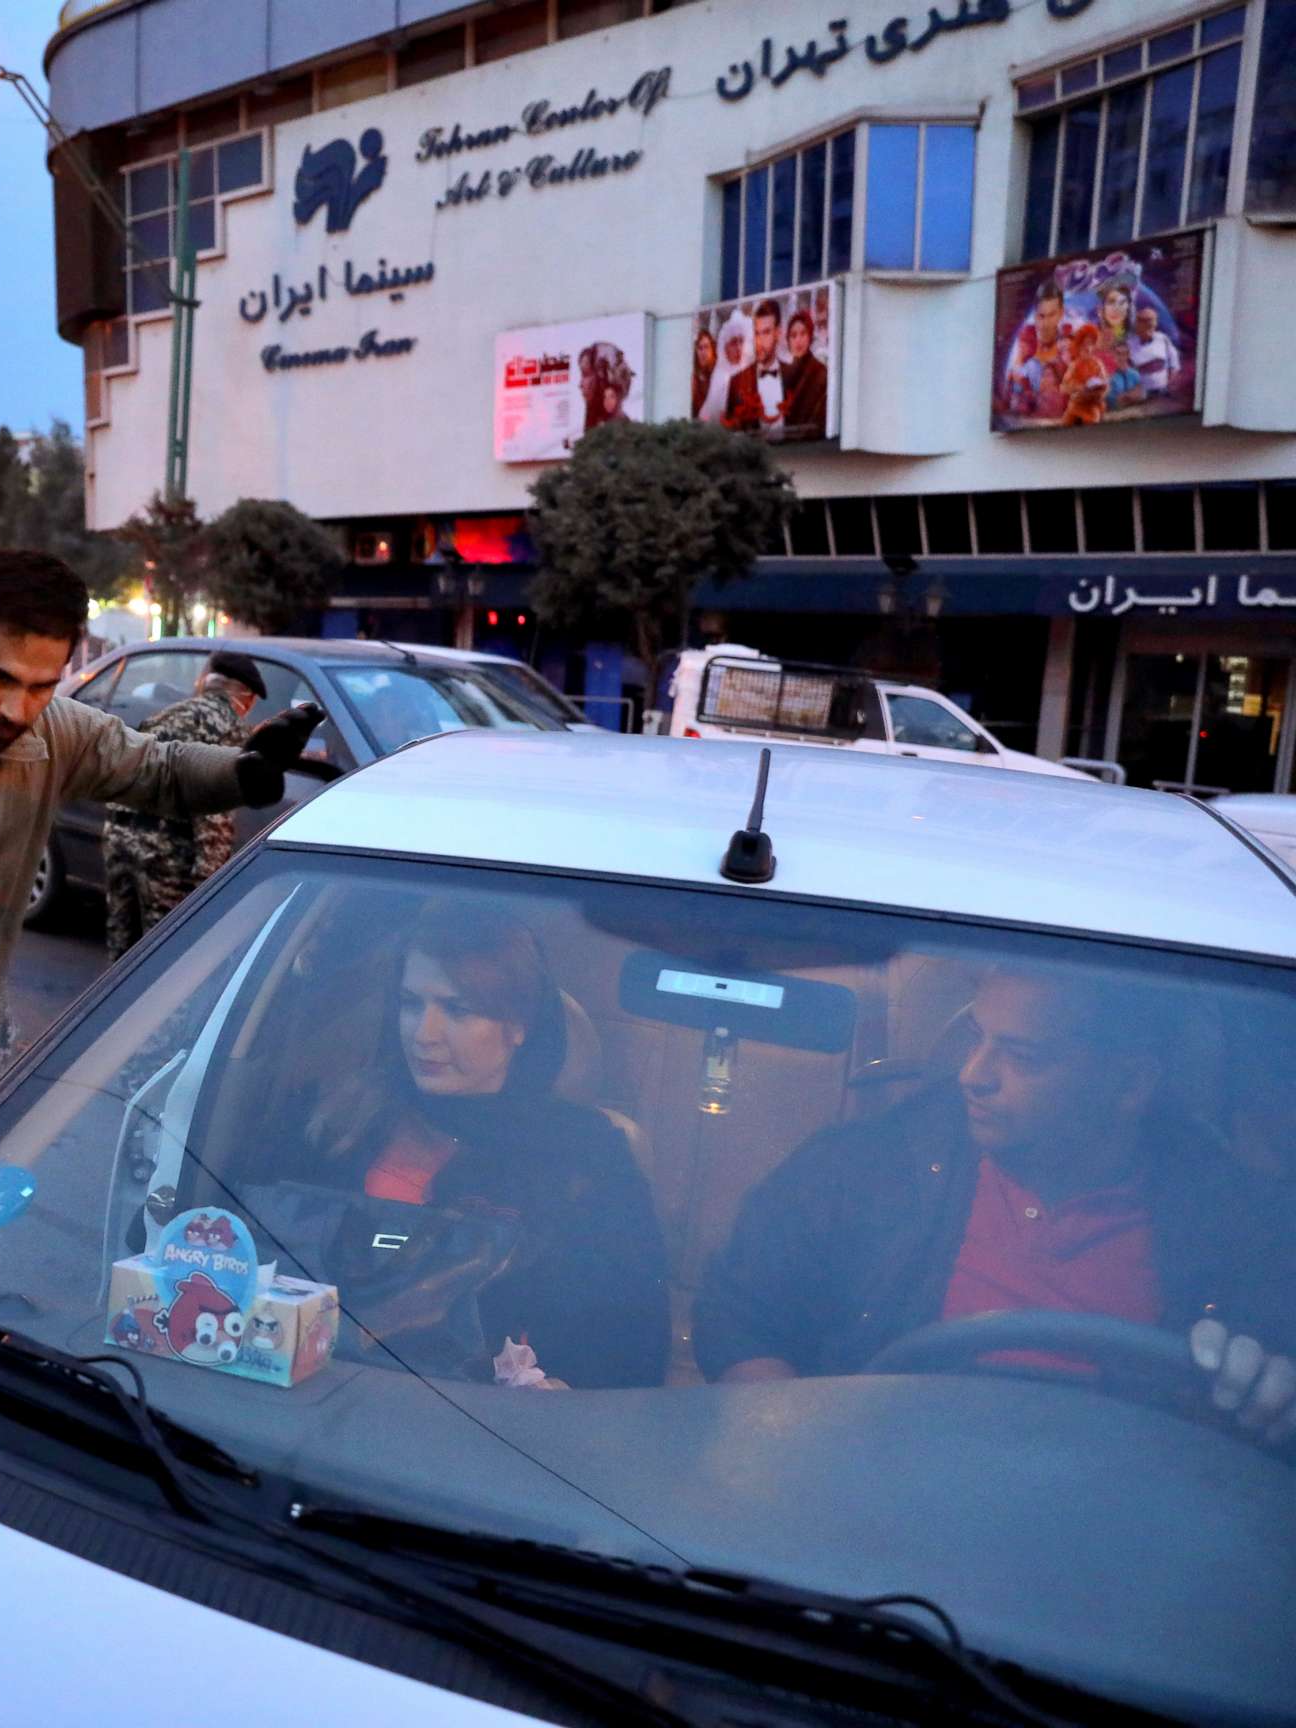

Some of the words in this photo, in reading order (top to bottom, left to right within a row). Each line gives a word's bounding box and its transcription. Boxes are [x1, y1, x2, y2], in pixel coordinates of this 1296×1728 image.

[716, 16, 851, 102] تهران
[415, 123, 516, 163] Tehran
[521, 88, 625, 135] Center
[435, 170, 491, 209] Art
[523, 147, 643, 189] Culture
[239, 265, 329, 324] ایران
[344, 258, 435, 302] سینما
[260, 344, 351, 373] Cinema
[354, 329, 418, 360] Iran
[1068, 574, 1218, 616] ایران
